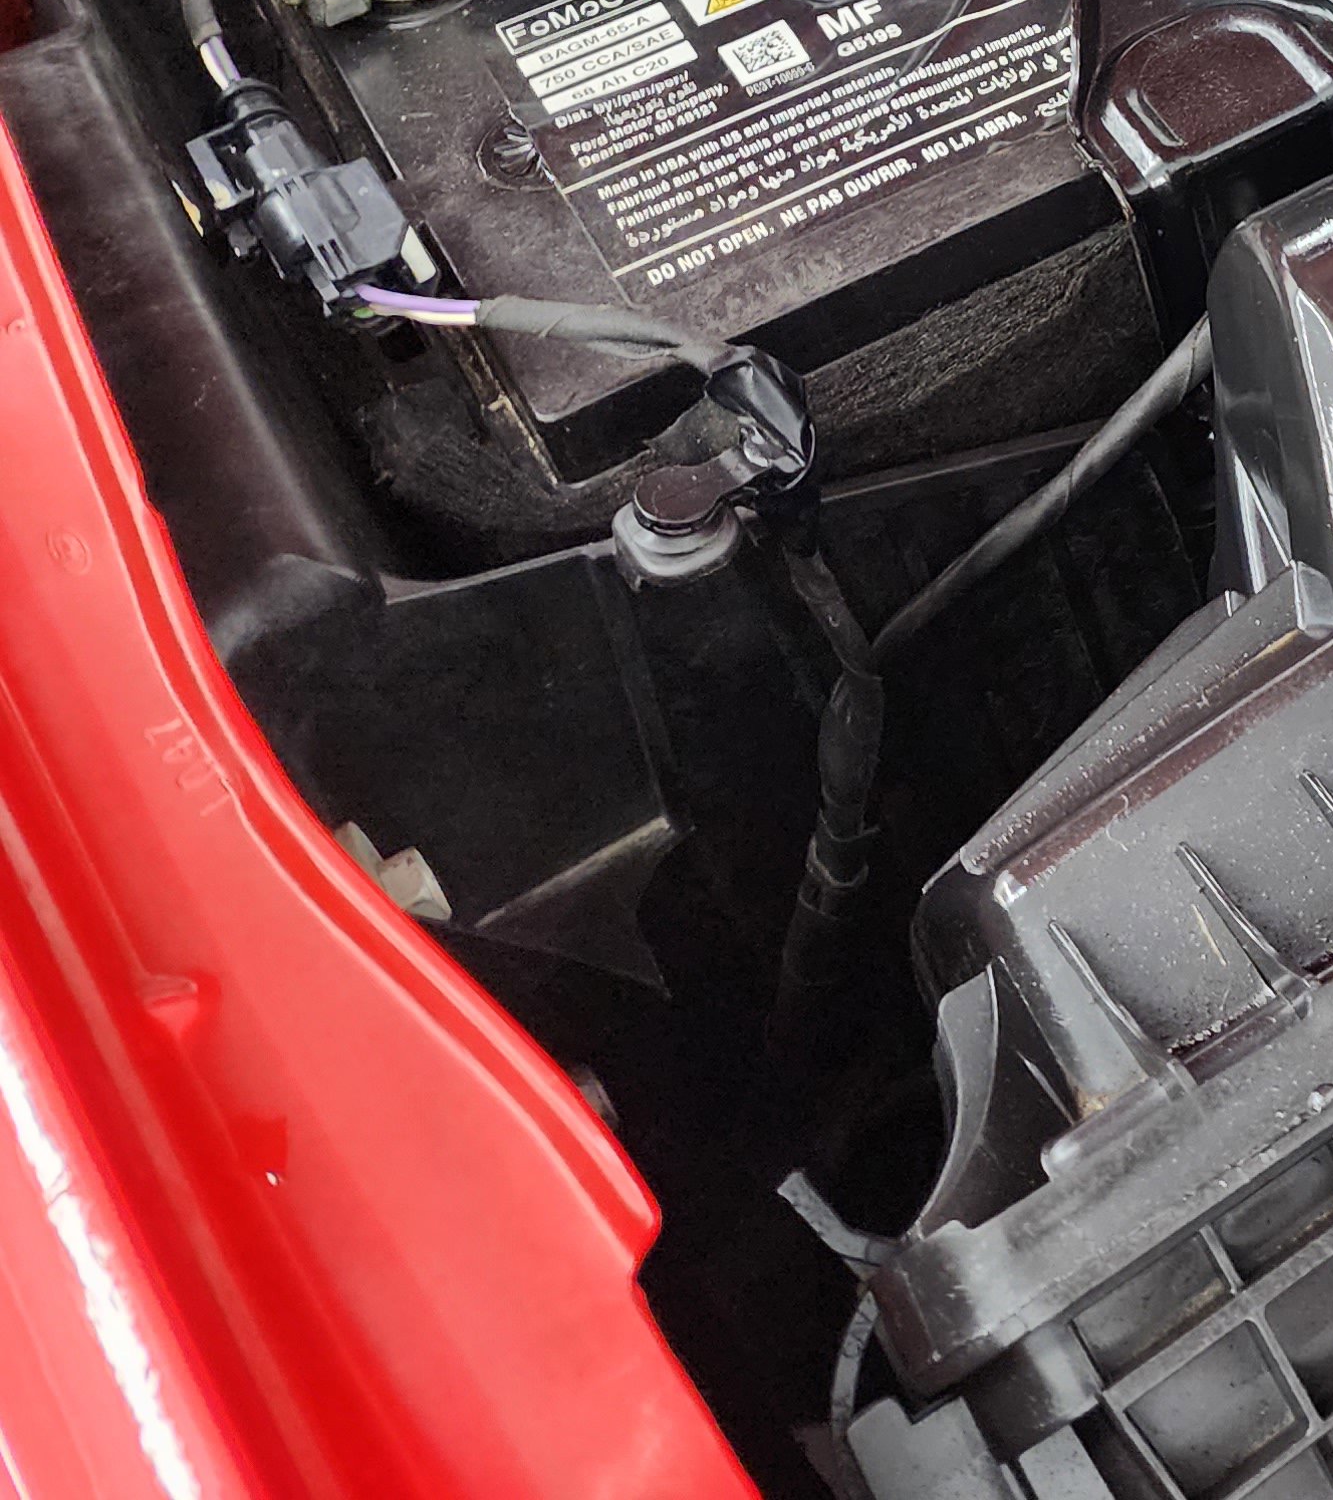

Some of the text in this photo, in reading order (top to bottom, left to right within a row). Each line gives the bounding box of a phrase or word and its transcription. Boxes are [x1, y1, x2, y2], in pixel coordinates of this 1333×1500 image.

[538, 15, 651, 65] BAGM-65-A
[539, 28, 674, 89] 750 CCA/SAE
[570, 55, 670, 102] 68 Ah C20
[569, 82, 729, 158] Ford Motor Company,
[653, 119, 675, 137] MI
[920, 140, 950, 163] NO
[948, 130, 976, 152] LA
[779, 204, 808, 228] NE
[805, 188, 844, 216] PAS
[646, 262, 676, 286] DO
[676, 243, 716, 273] NOT
